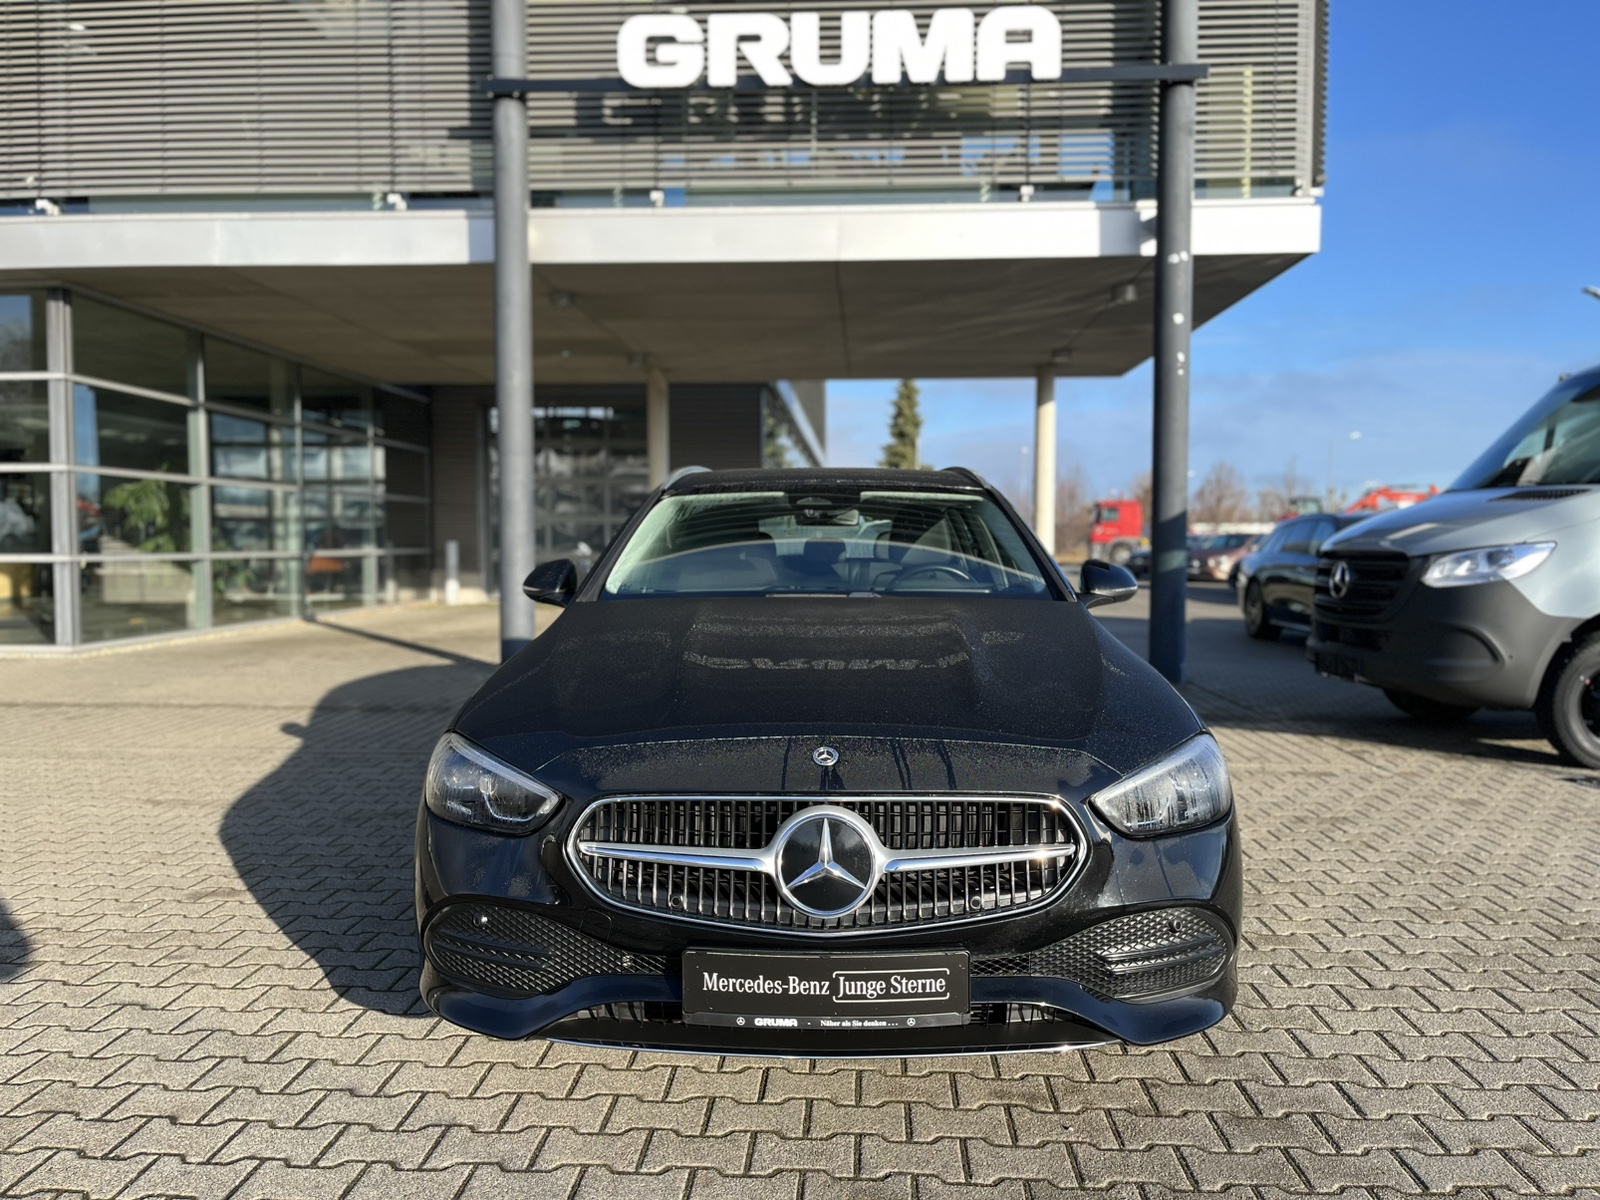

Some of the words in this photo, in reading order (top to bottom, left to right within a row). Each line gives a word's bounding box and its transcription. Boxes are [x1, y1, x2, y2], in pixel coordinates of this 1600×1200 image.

[617, 5, 1063, 88] GRUMA
[702, 971, 830, 996] Mercedes-Benz
[837, 975, 886, 999] Junge
[890, 974, 946, 995] Sterne
[754, 1017, 798, 1028] GRUMA
[820, 1019, 841, 1028] Näher
[841, 1019, 852, 1028] als
[851, 1019, 863, 1028] Sie
